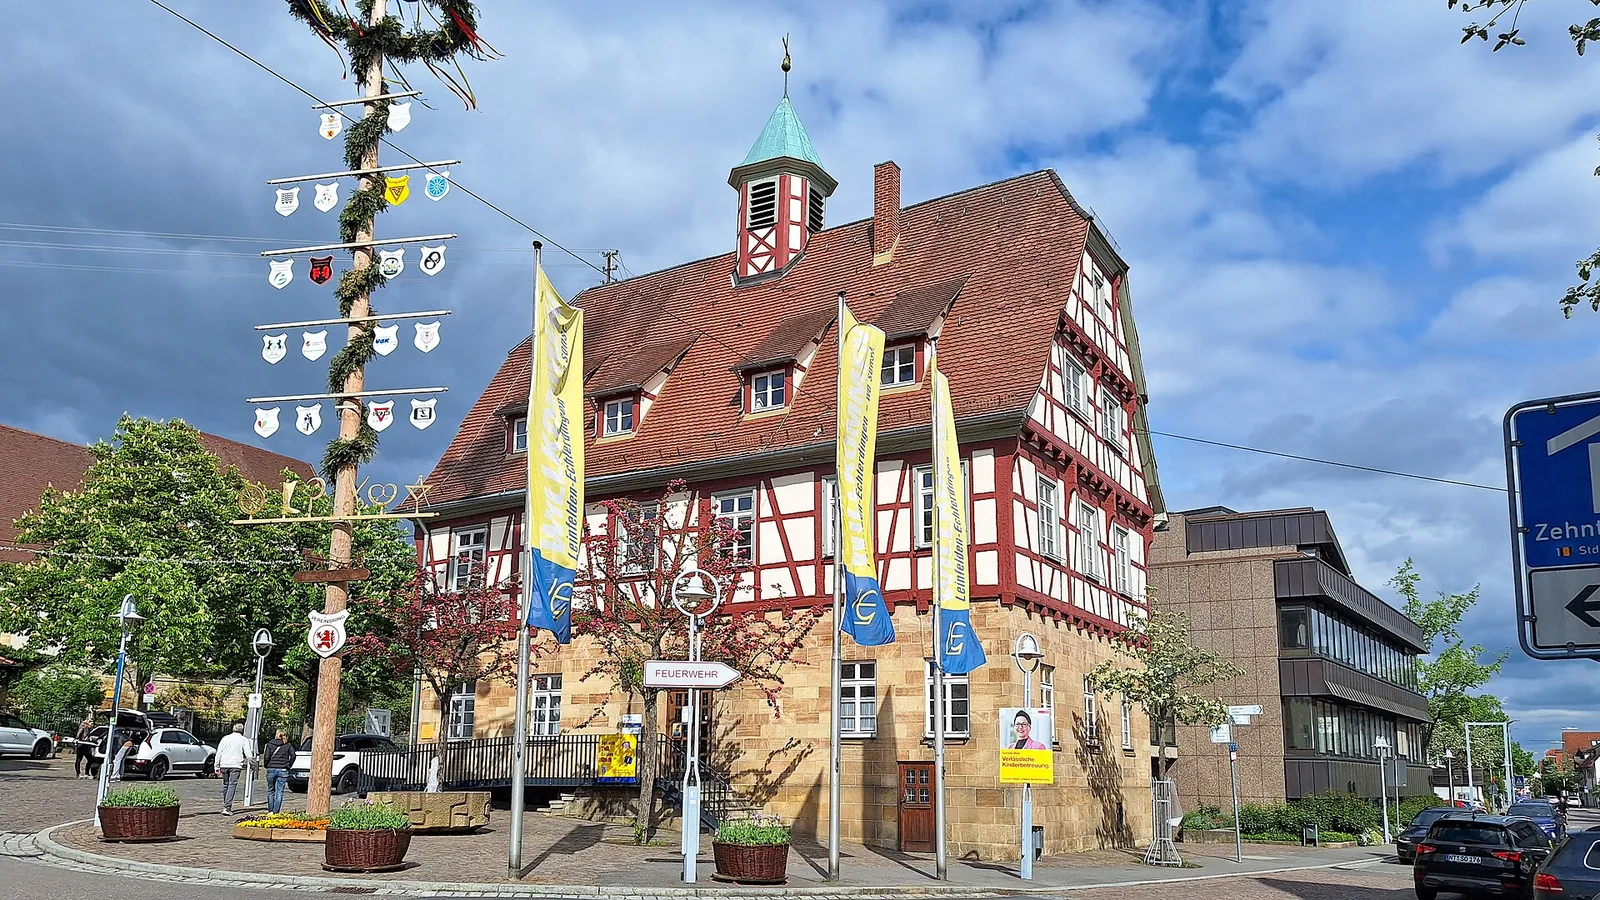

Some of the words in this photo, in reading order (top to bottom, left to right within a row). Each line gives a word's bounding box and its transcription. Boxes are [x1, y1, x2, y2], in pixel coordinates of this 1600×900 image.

[557, 397, 578, 561] Leinfelden-Echterdingen
[947, 456, 966, 602] Leinfelden-Echterdingen
[655, 669, 718, 679] FEUERWEHR
